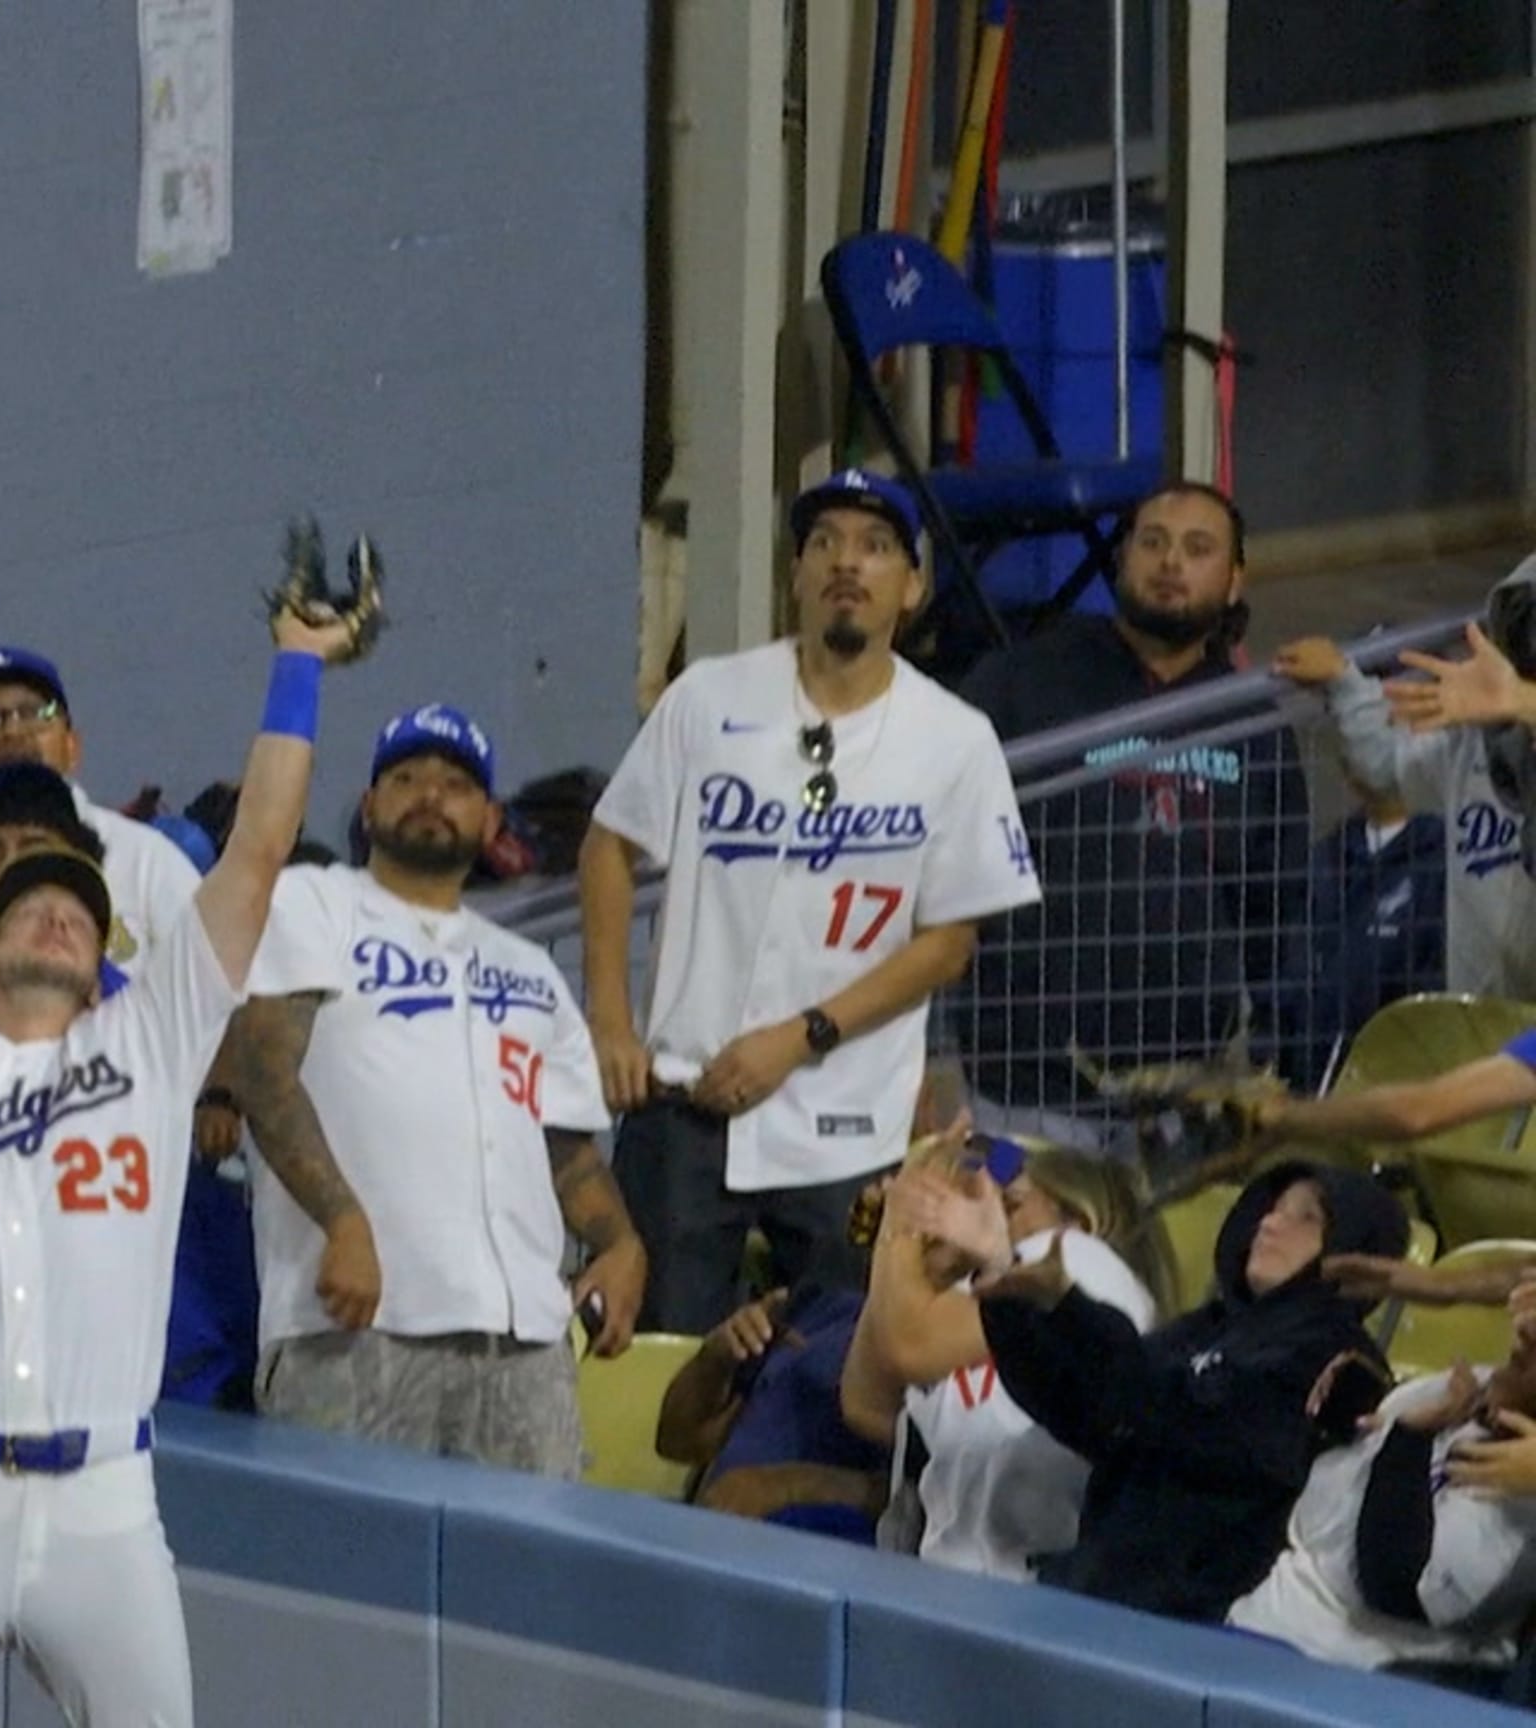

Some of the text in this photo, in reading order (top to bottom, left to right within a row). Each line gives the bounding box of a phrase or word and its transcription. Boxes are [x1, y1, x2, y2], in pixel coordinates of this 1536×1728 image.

[699, 773, 928, 873] Dodgers
[824, 880, 904, 953] 17
[52, 1135, 151, 1213] 23
